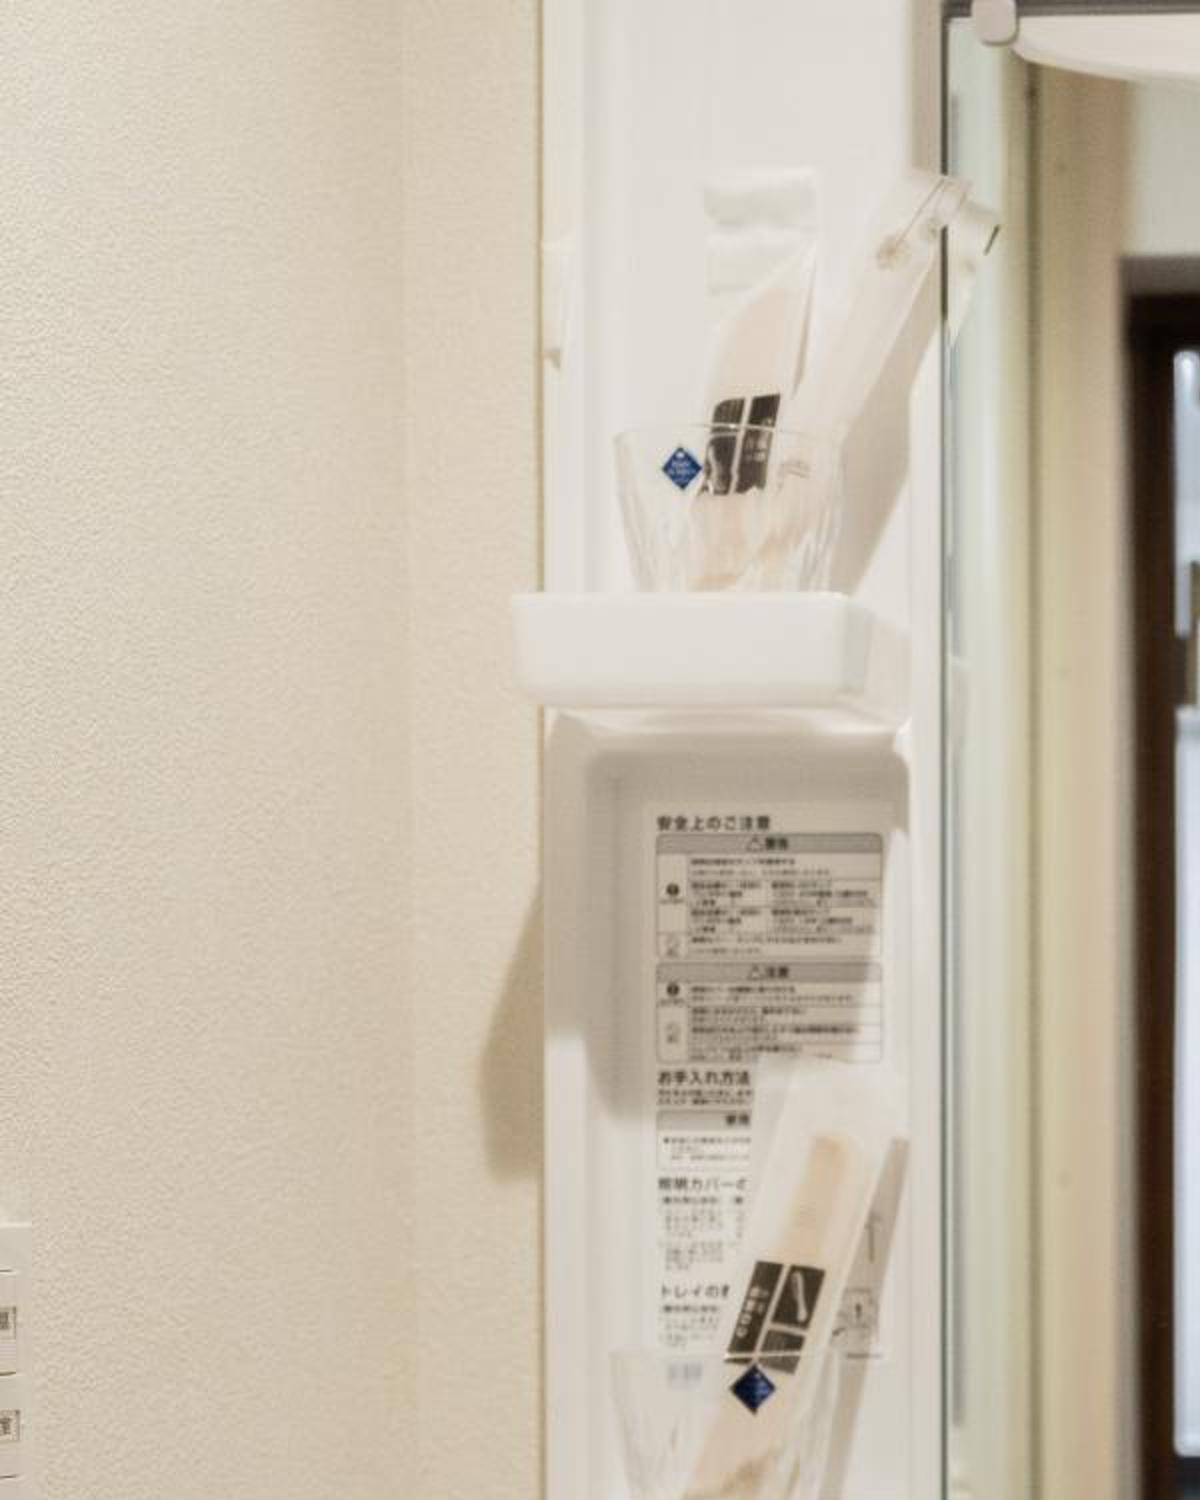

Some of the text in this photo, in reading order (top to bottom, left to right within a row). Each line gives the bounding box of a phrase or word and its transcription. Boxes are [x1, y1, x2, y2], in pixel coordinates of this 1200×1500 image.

[657, 815, 770, 831] 安全上のご注意
[657, 1070, 750, 1086] お手入れ方法
